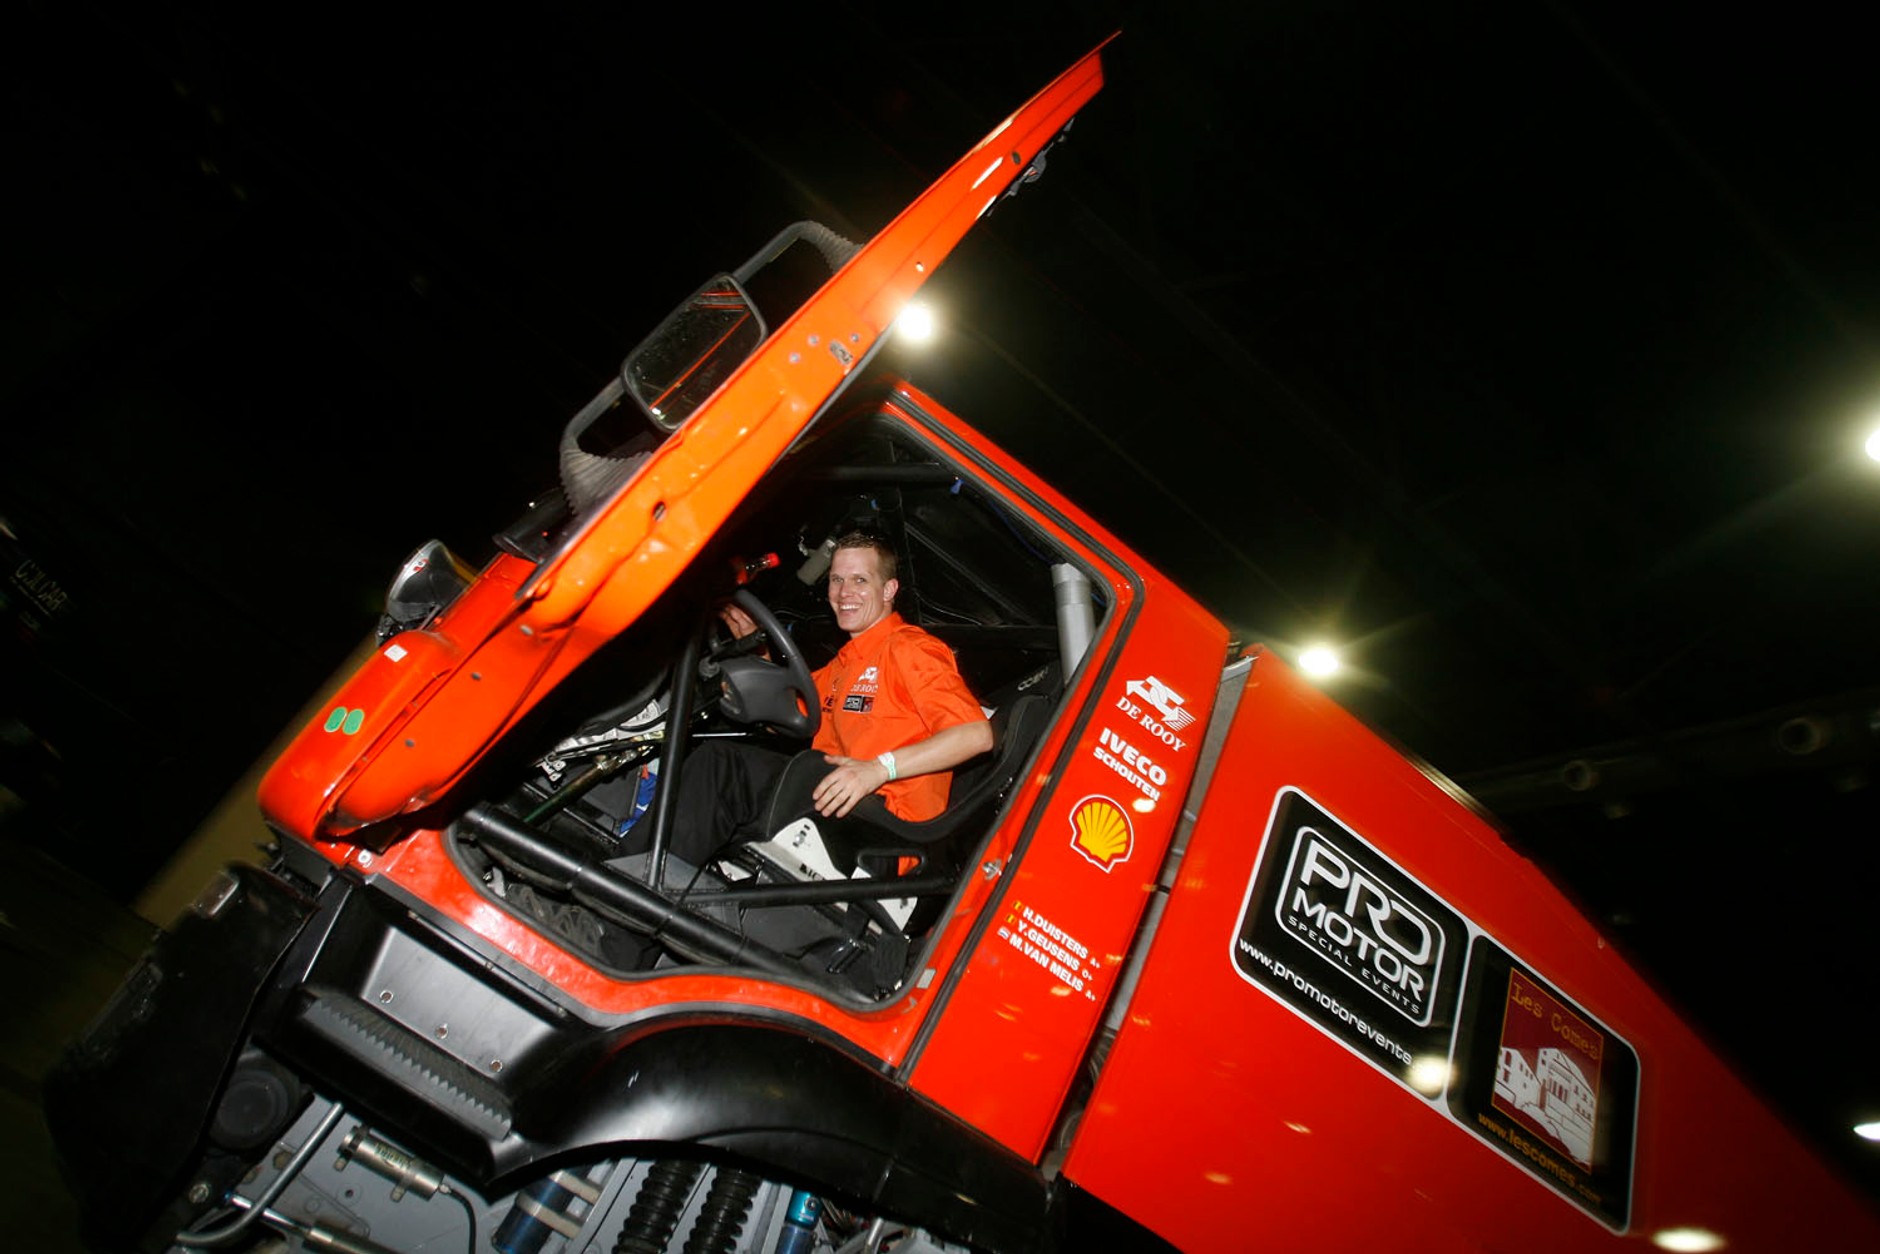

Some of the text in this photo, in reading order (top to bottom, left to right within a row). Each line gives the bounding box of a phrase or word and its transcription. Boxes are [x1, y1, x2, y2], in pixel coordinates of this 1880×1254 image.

[1115, 696, 1187, 752] DE ROOY
[1093, 746, 1161, 801] SCHOUTEN
[1099, 727, 1167, 786] IVECO
[1300, 839, 1432, 966] PRO
[1018, 919, 1080, 971] Y.GEUSENS
[1023, 906, 1089, 959] H.DUISTERS
[1292, 887, 1424, 1002] MOTOR
[1009, 933, 1050, 968] M.VAN
[1049, 961, 1084, 992] MELIS
[1288, 915, 1420, 1015] SPECIAL EVENTS
[1511, 982, 1599, 1060] Les Comes
